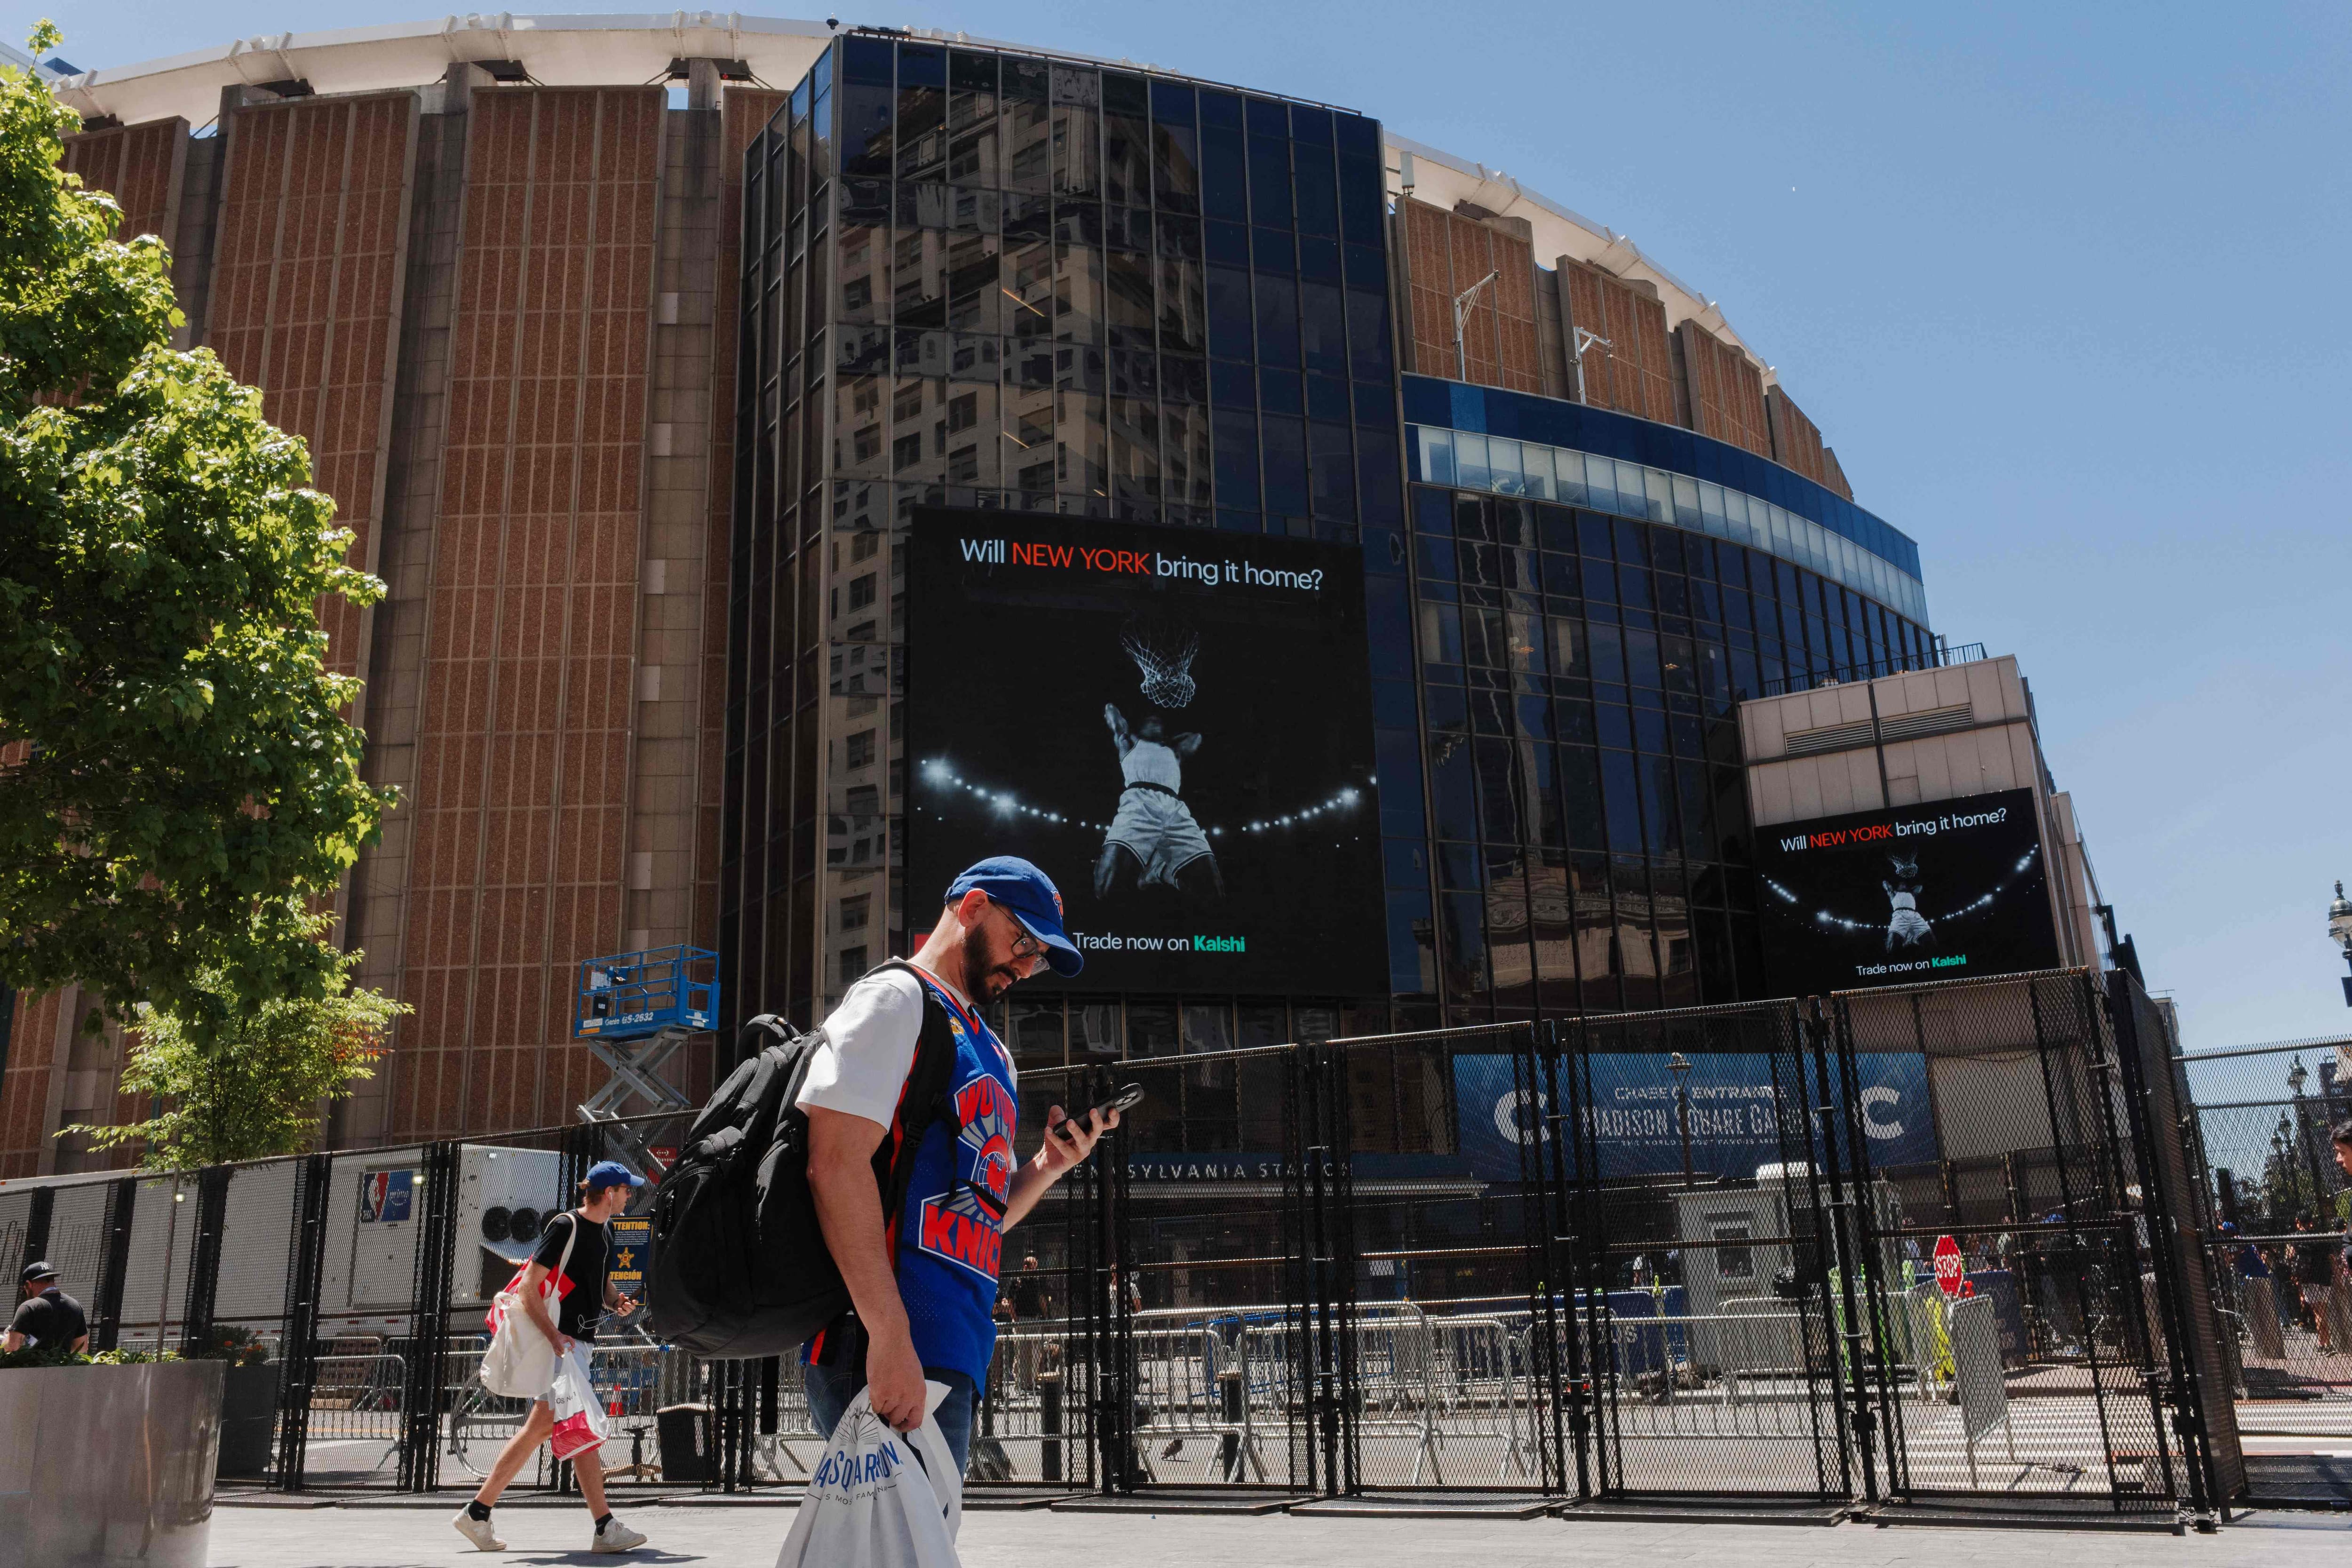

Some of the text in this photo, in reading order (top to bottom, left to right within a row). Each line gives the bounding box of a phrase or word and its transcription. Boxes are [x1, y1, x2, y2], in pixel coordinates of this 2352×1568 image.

[960, 539, 1323, 591] Will NEW YORK bring it home?
[1781, 808, 2007, 852] Will NEW YORK bring it home?
[1072, 932, 1246, 953] Trade now on Kalshi
[1856, 954, 1967, 976] Trade now on Kalshi
[957, 1077, 994, 1129] WU
[613, 1221, 650, 1231] TTENTION:
[610, 1269, 642, 1280] TENCIÓN
[1935, 1255, 1960, 1278] STOP
